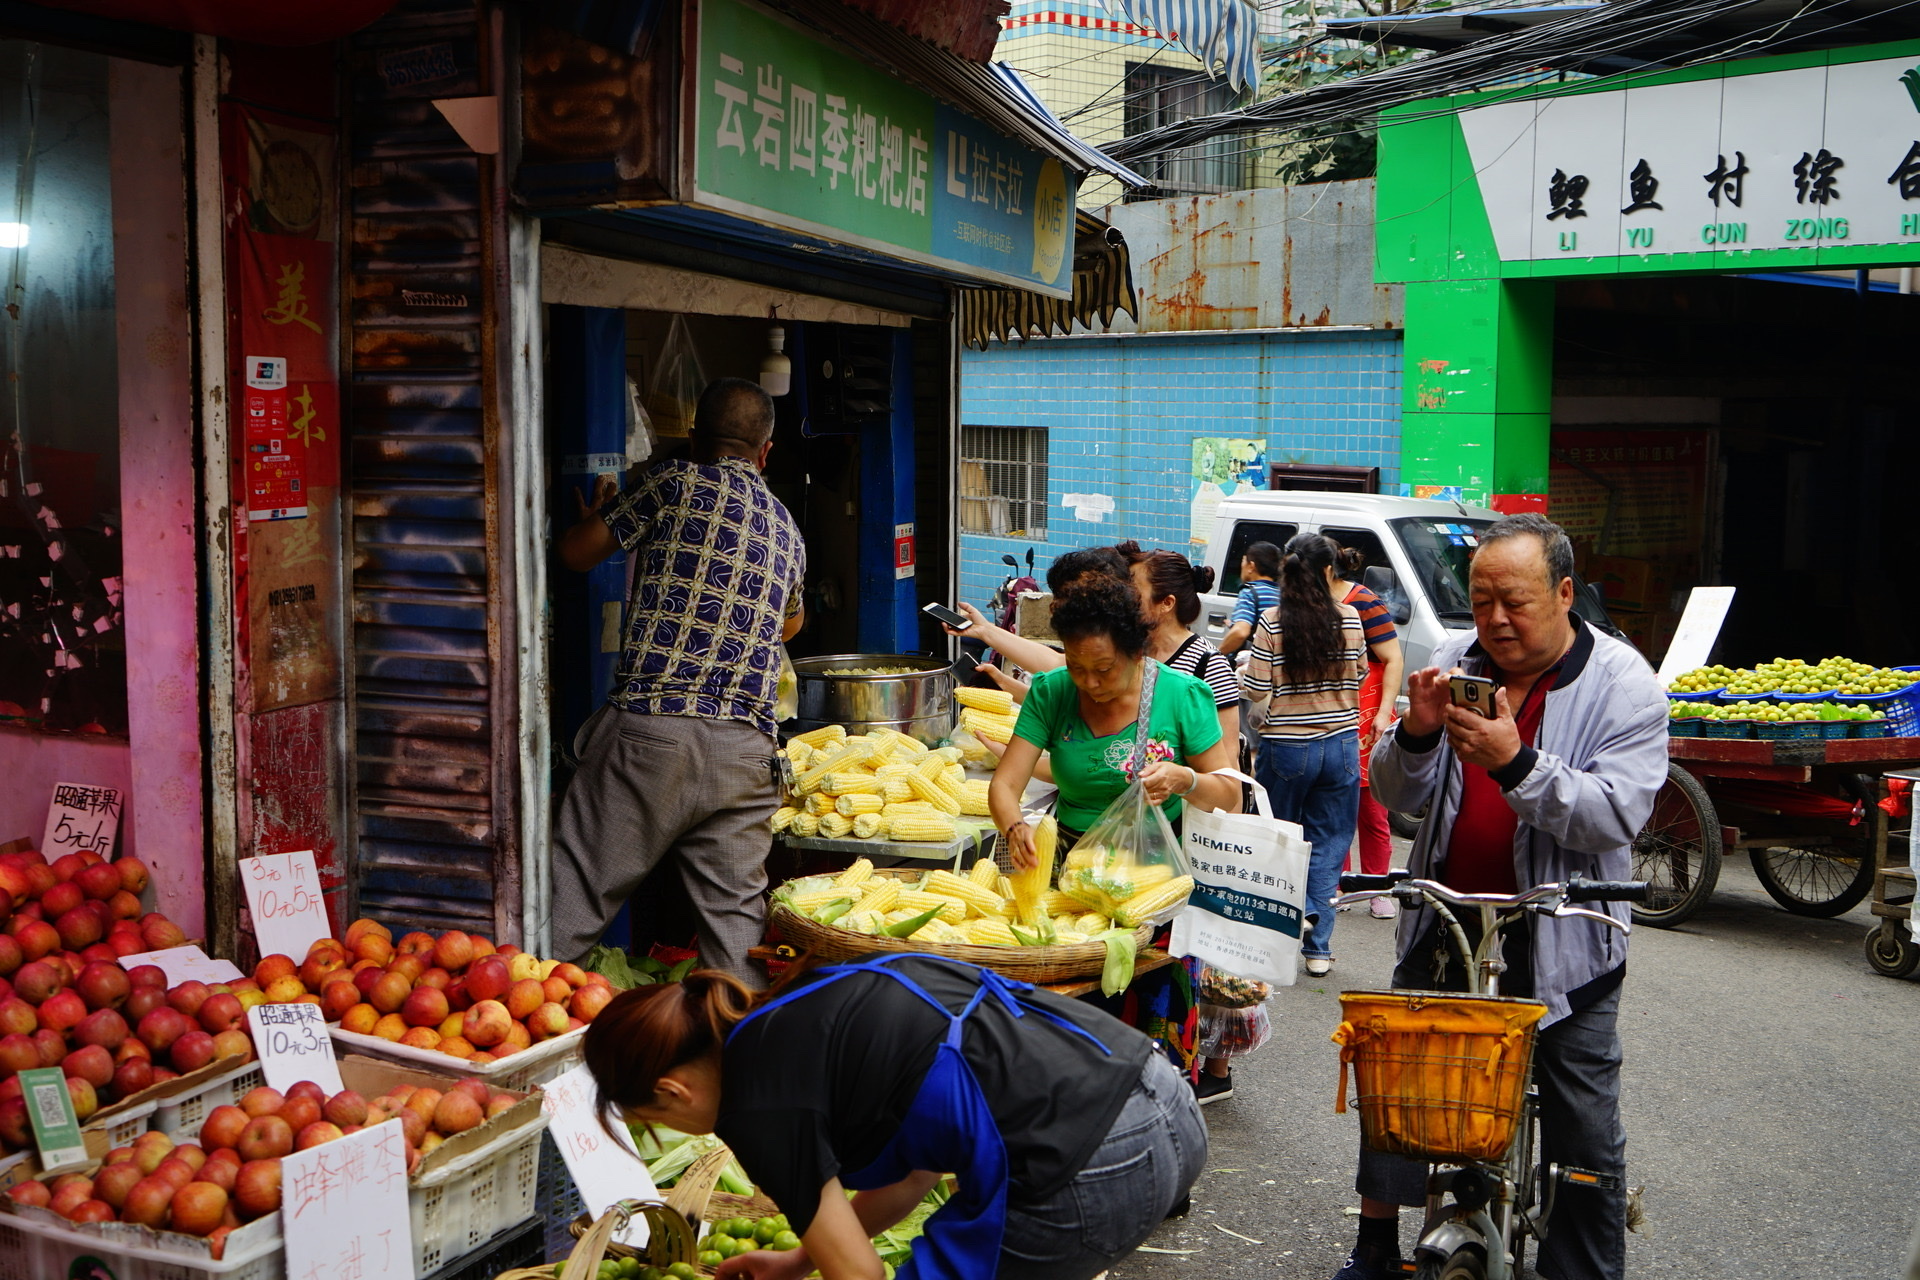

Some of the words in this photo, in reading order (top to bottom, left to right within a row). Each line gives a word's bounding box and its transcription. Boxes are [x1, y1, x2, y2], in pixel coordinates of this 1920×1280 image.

[714, 52, 928, 217] 云岩四季粑粑店
[971, 142, 1024, 217] 拉卡拉
[1546, 139, 1920, 221] 鲤鱼村综合
[1038, 187, 1063, 237] 小店
[1558, 231, 1577, 251] LI
[1627, 227, 1654, 248] YU
[1701, 222, 1747, 245] CUN
[1784, 216, 1849, 240] ZONG
[1900, 213, 1920, 236] H
[54, 785, 119, 819] 昭通苹果
[1191, 832, 1253, 855] SIEMENS
[258, 885, 320, 923] 10元5斤
[1222, 904, 1255, 922] 遵义站
[258, 1003, 323, 1028] 昭通苹果
[266, 1027, 331, 1061] 10元3斤
